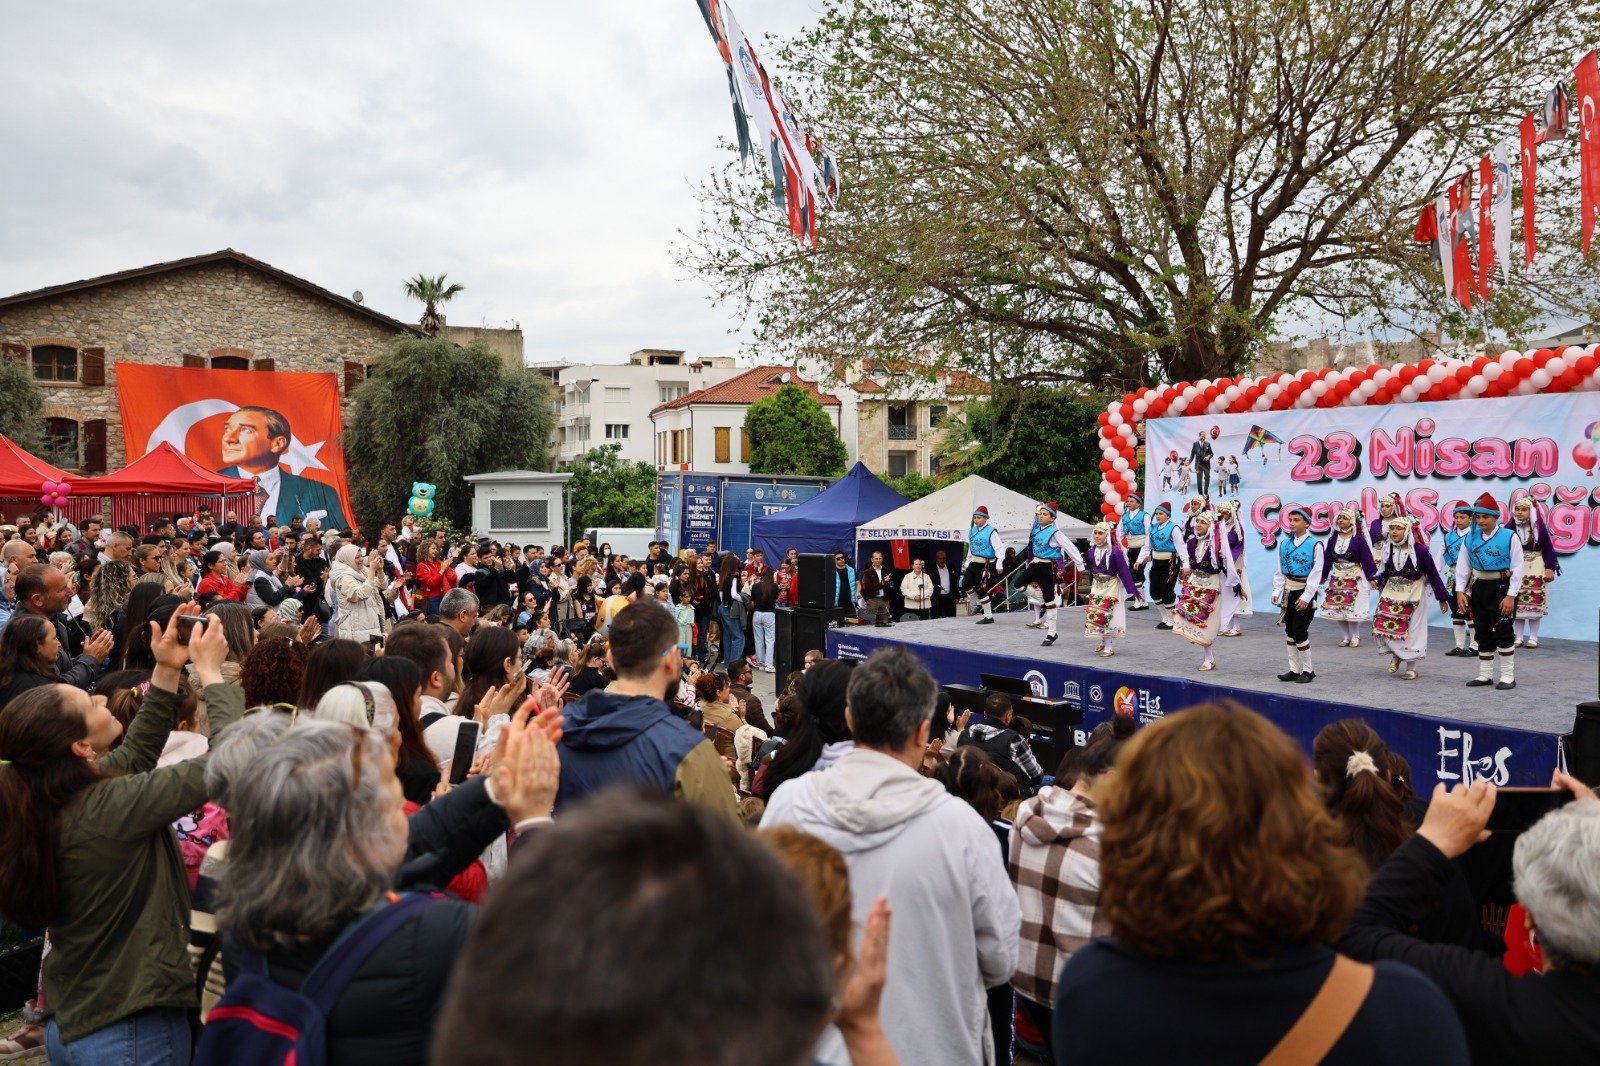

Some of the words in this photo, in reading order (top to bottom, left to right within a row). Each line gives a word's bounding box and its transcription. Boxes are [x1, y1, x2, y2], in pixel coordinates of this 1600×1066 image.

[1288, 431, 1357, 481] 23
[1369, 417, 1559, 477] Nisan
[868, 529, 899, 539] SELÇUK
[901, 529, 951, 539] BELEDİYESİ
[1138, 689, 1161, 713] Efes
[1436, 725, 1513, 789] Efes
